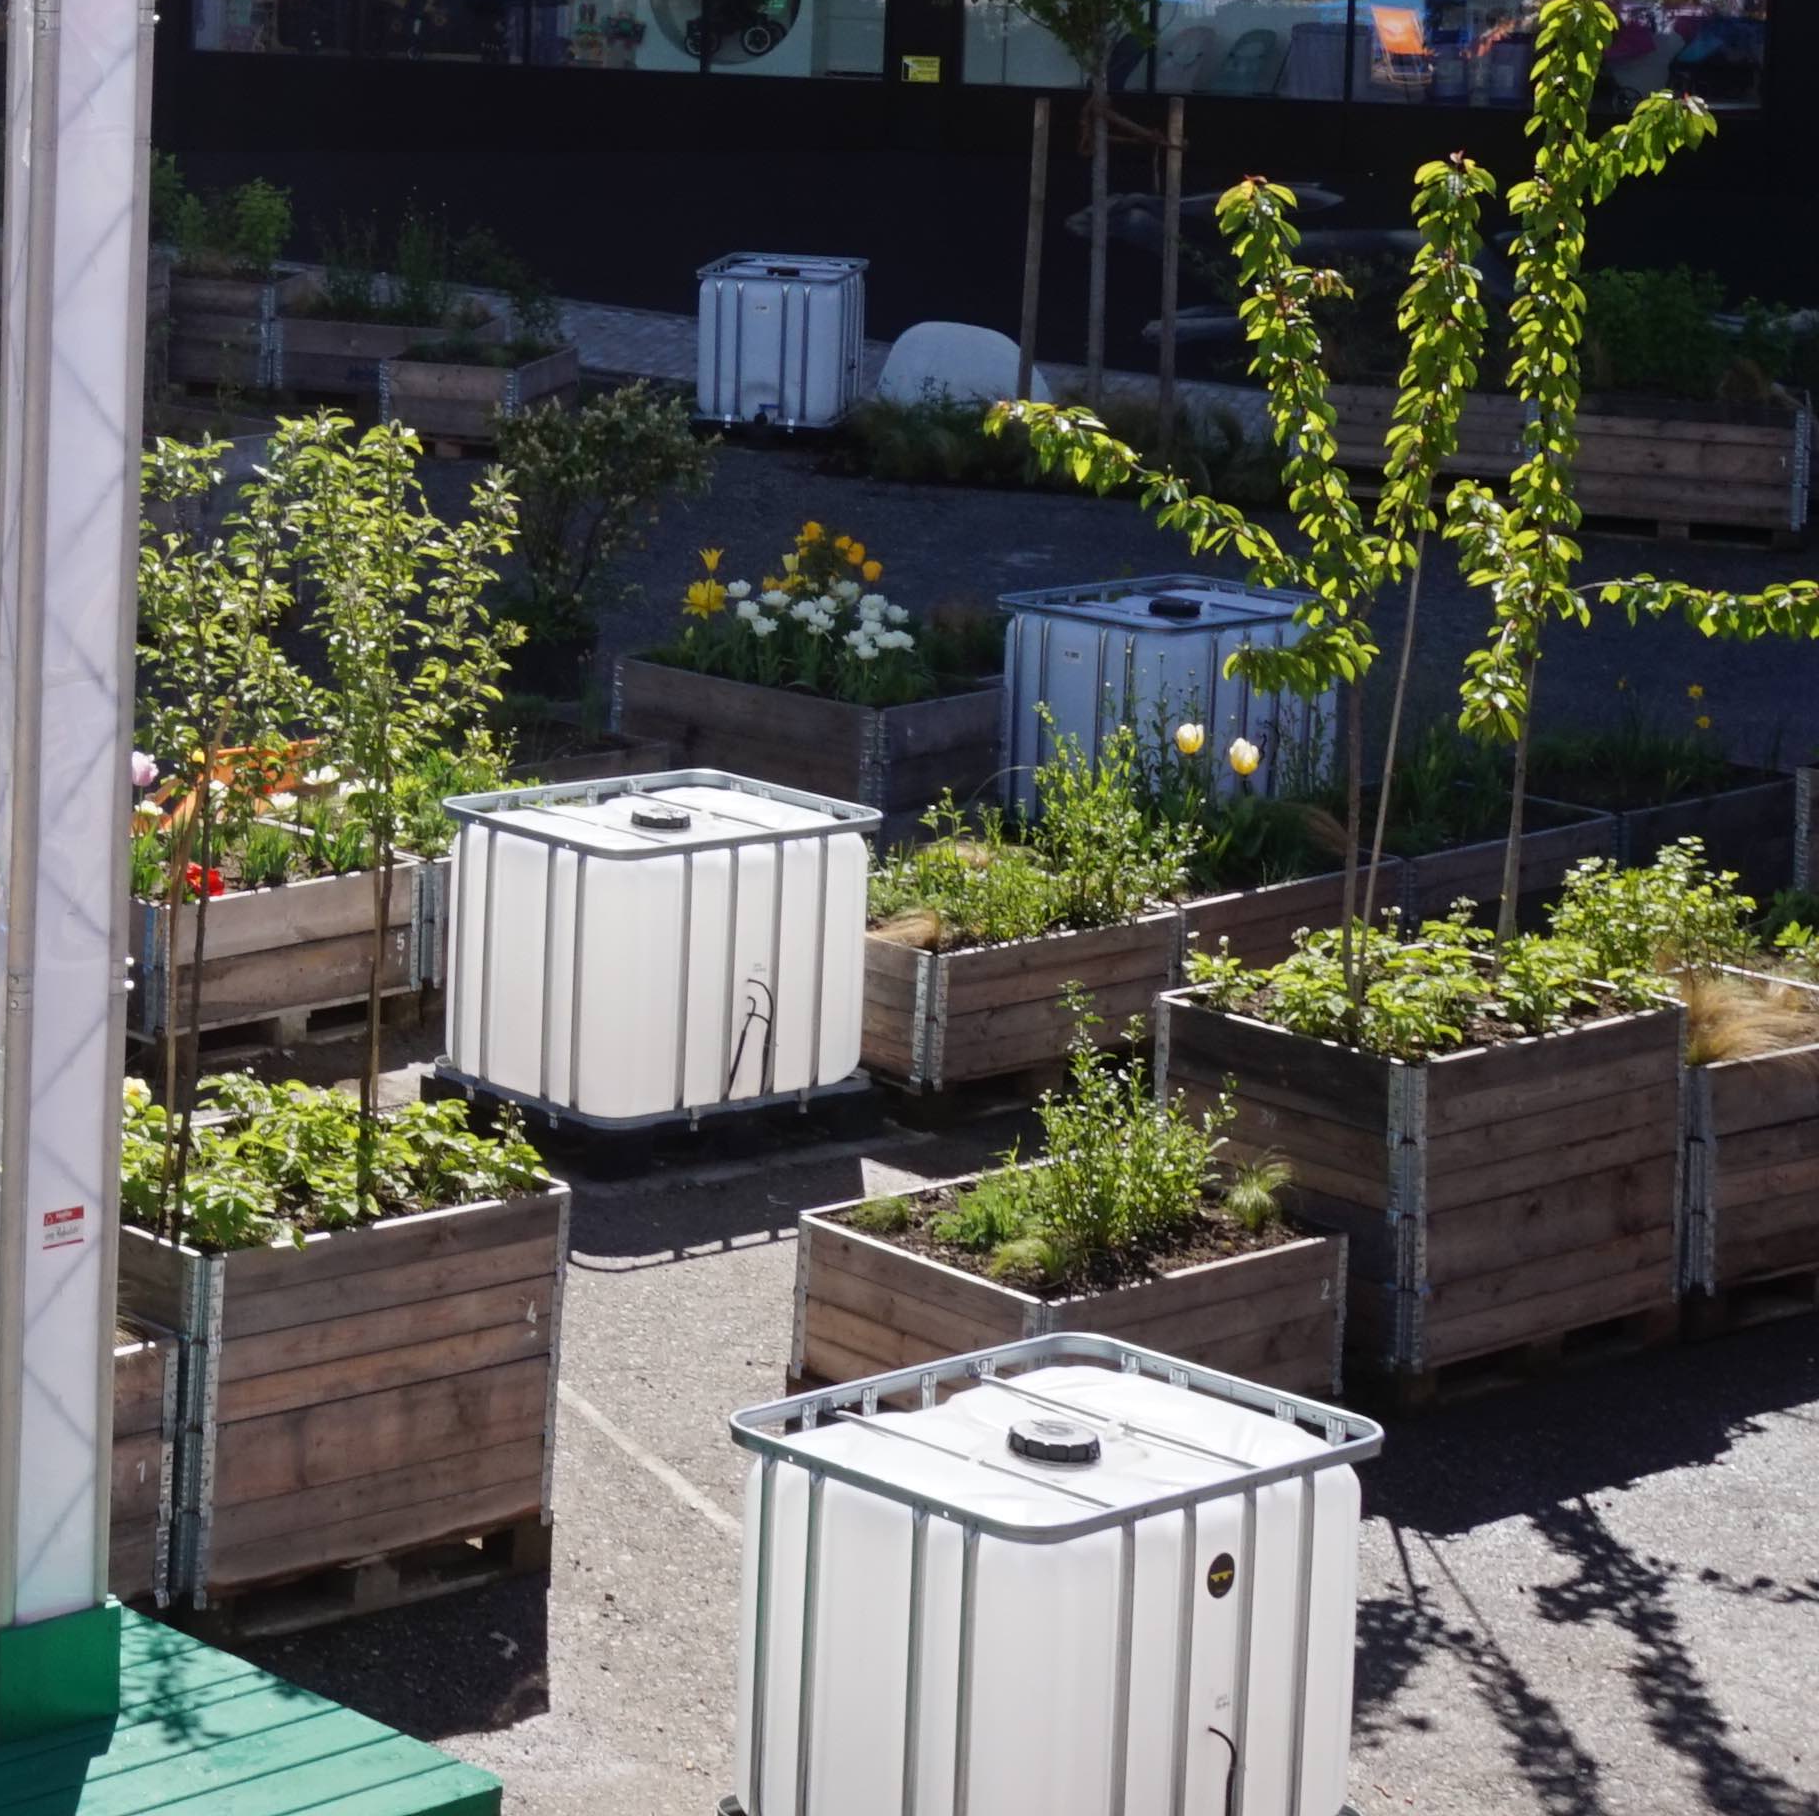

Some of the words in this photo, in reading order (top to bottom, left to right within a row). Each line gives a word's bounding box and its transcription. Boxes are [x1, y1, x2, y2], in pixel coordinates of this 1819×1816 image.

[396, 932, 406, 951] 5
[1319, 1279, 1331, 1302] 2
[136, 1460, 147, 1484] 1
